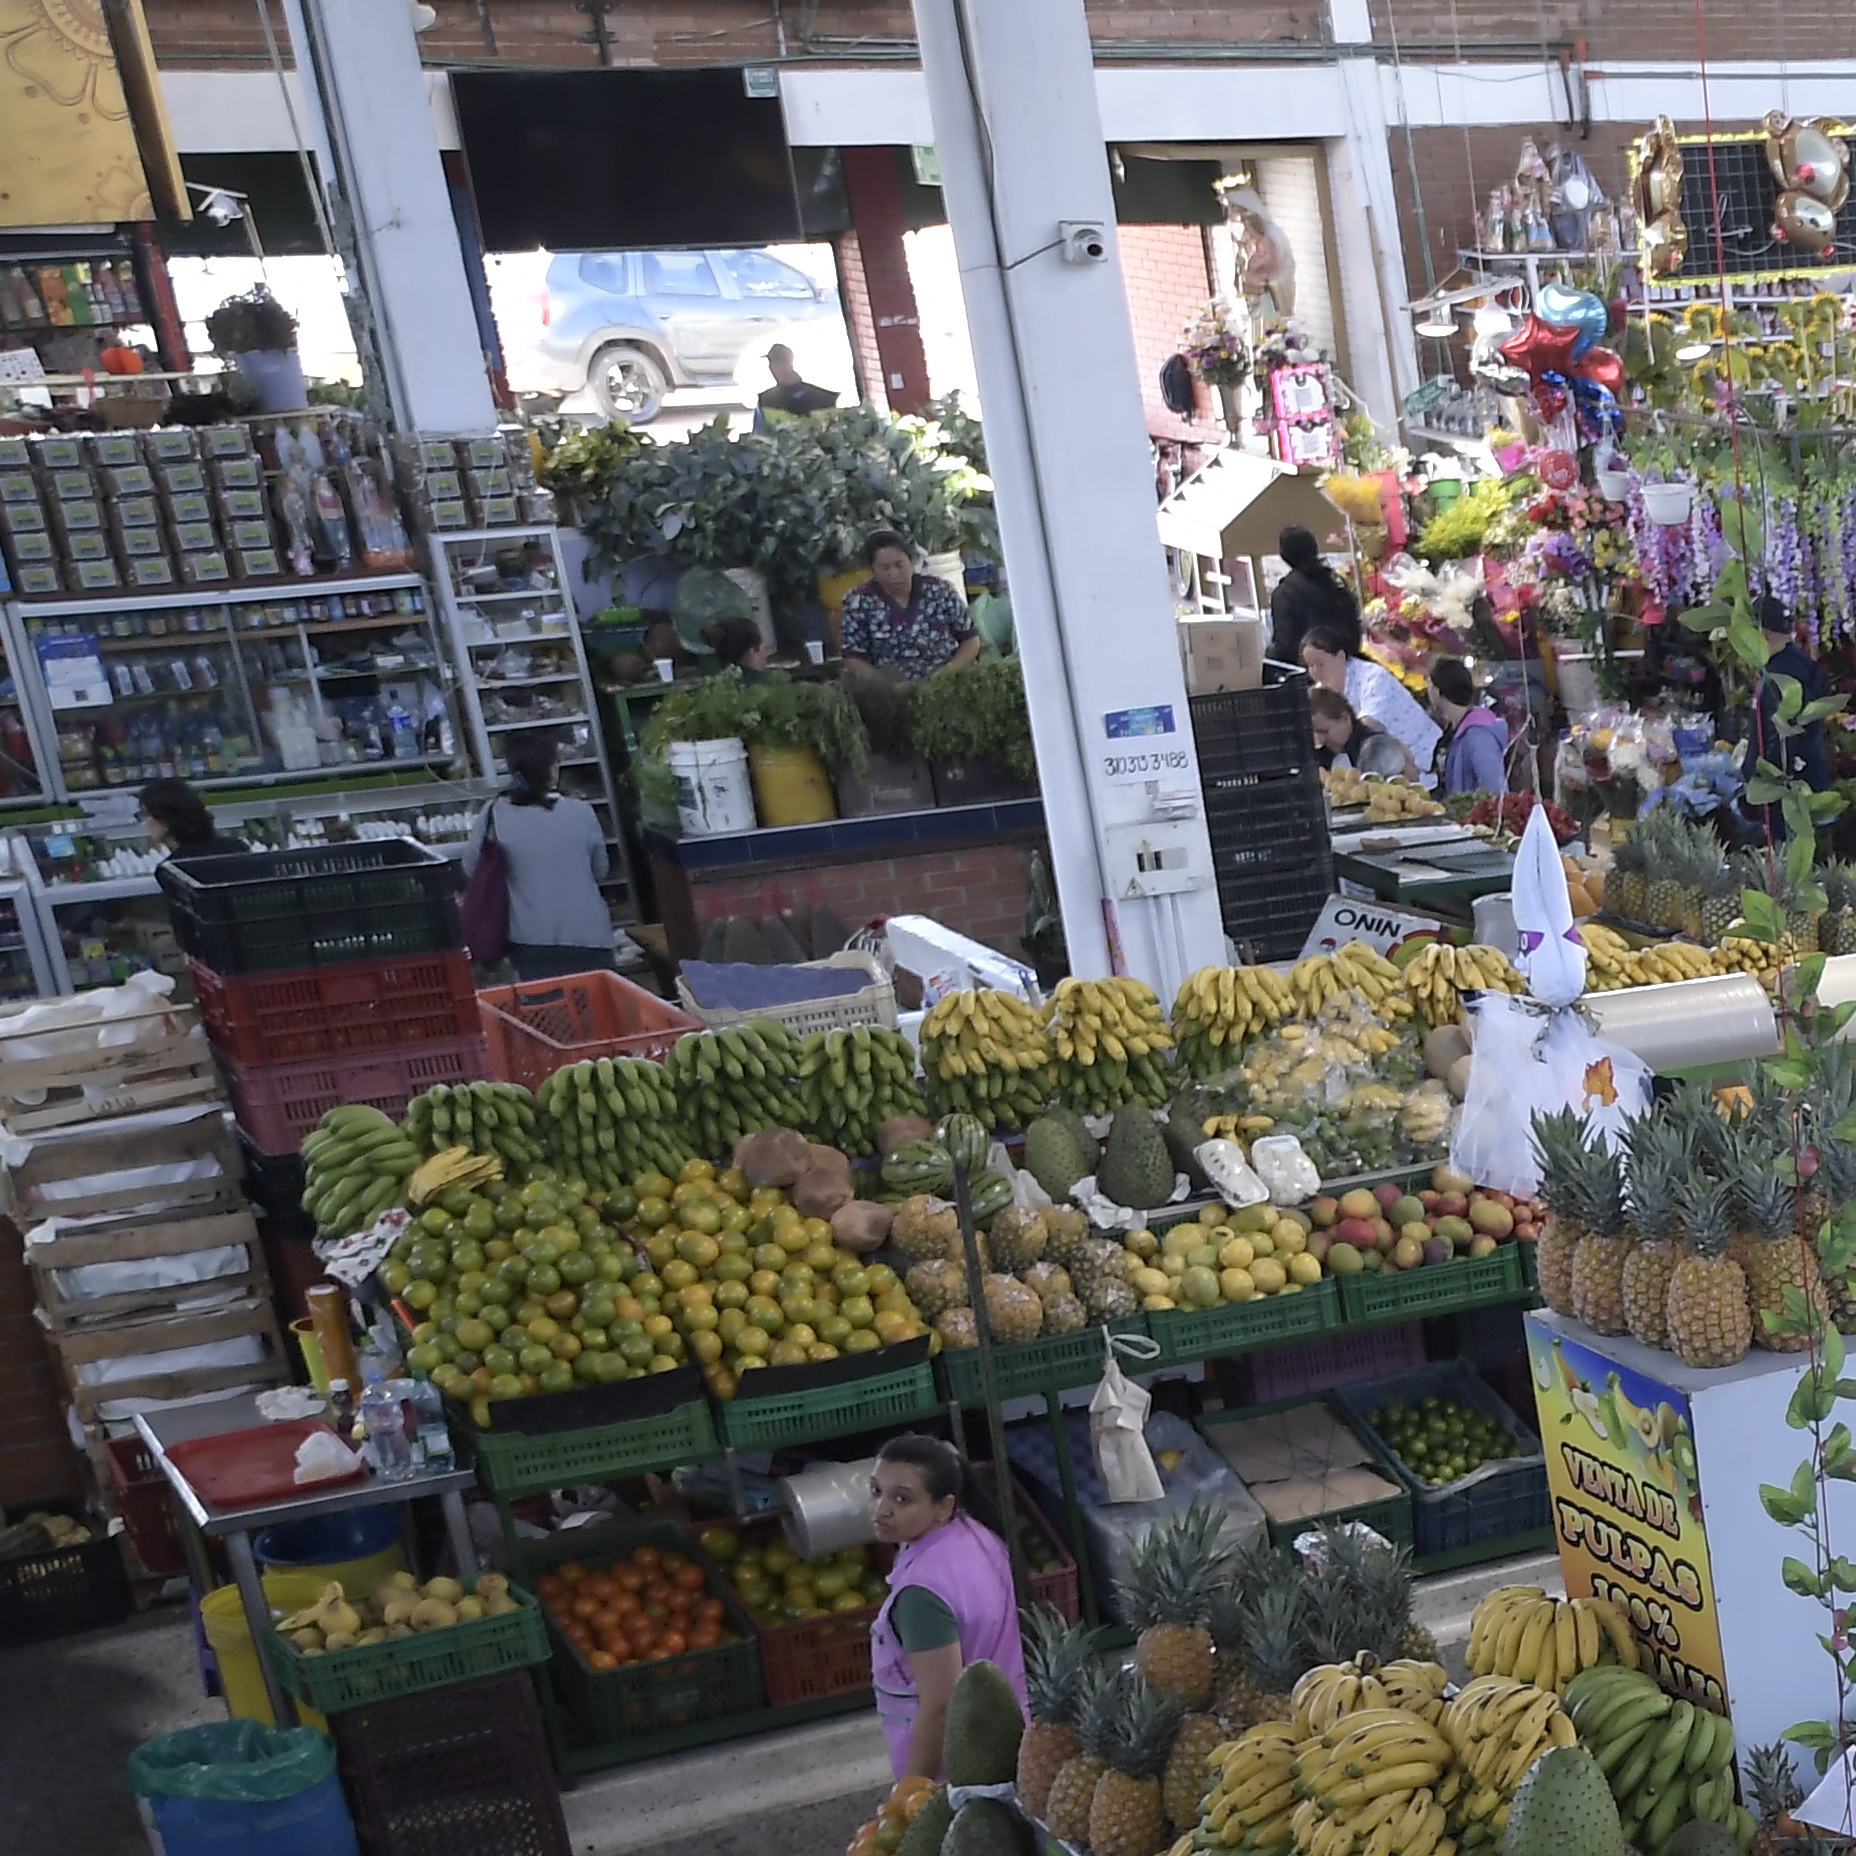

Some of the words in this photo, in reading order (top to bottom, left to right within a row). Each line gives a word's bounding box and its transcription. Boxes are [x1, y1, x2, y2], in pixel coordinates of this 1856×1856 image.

[1561, 1442, 1644, 1522] VENTA
[1643, 1480, 1681, 1541] DE
[1556, 1496, 1704, 1612] PULPAS
